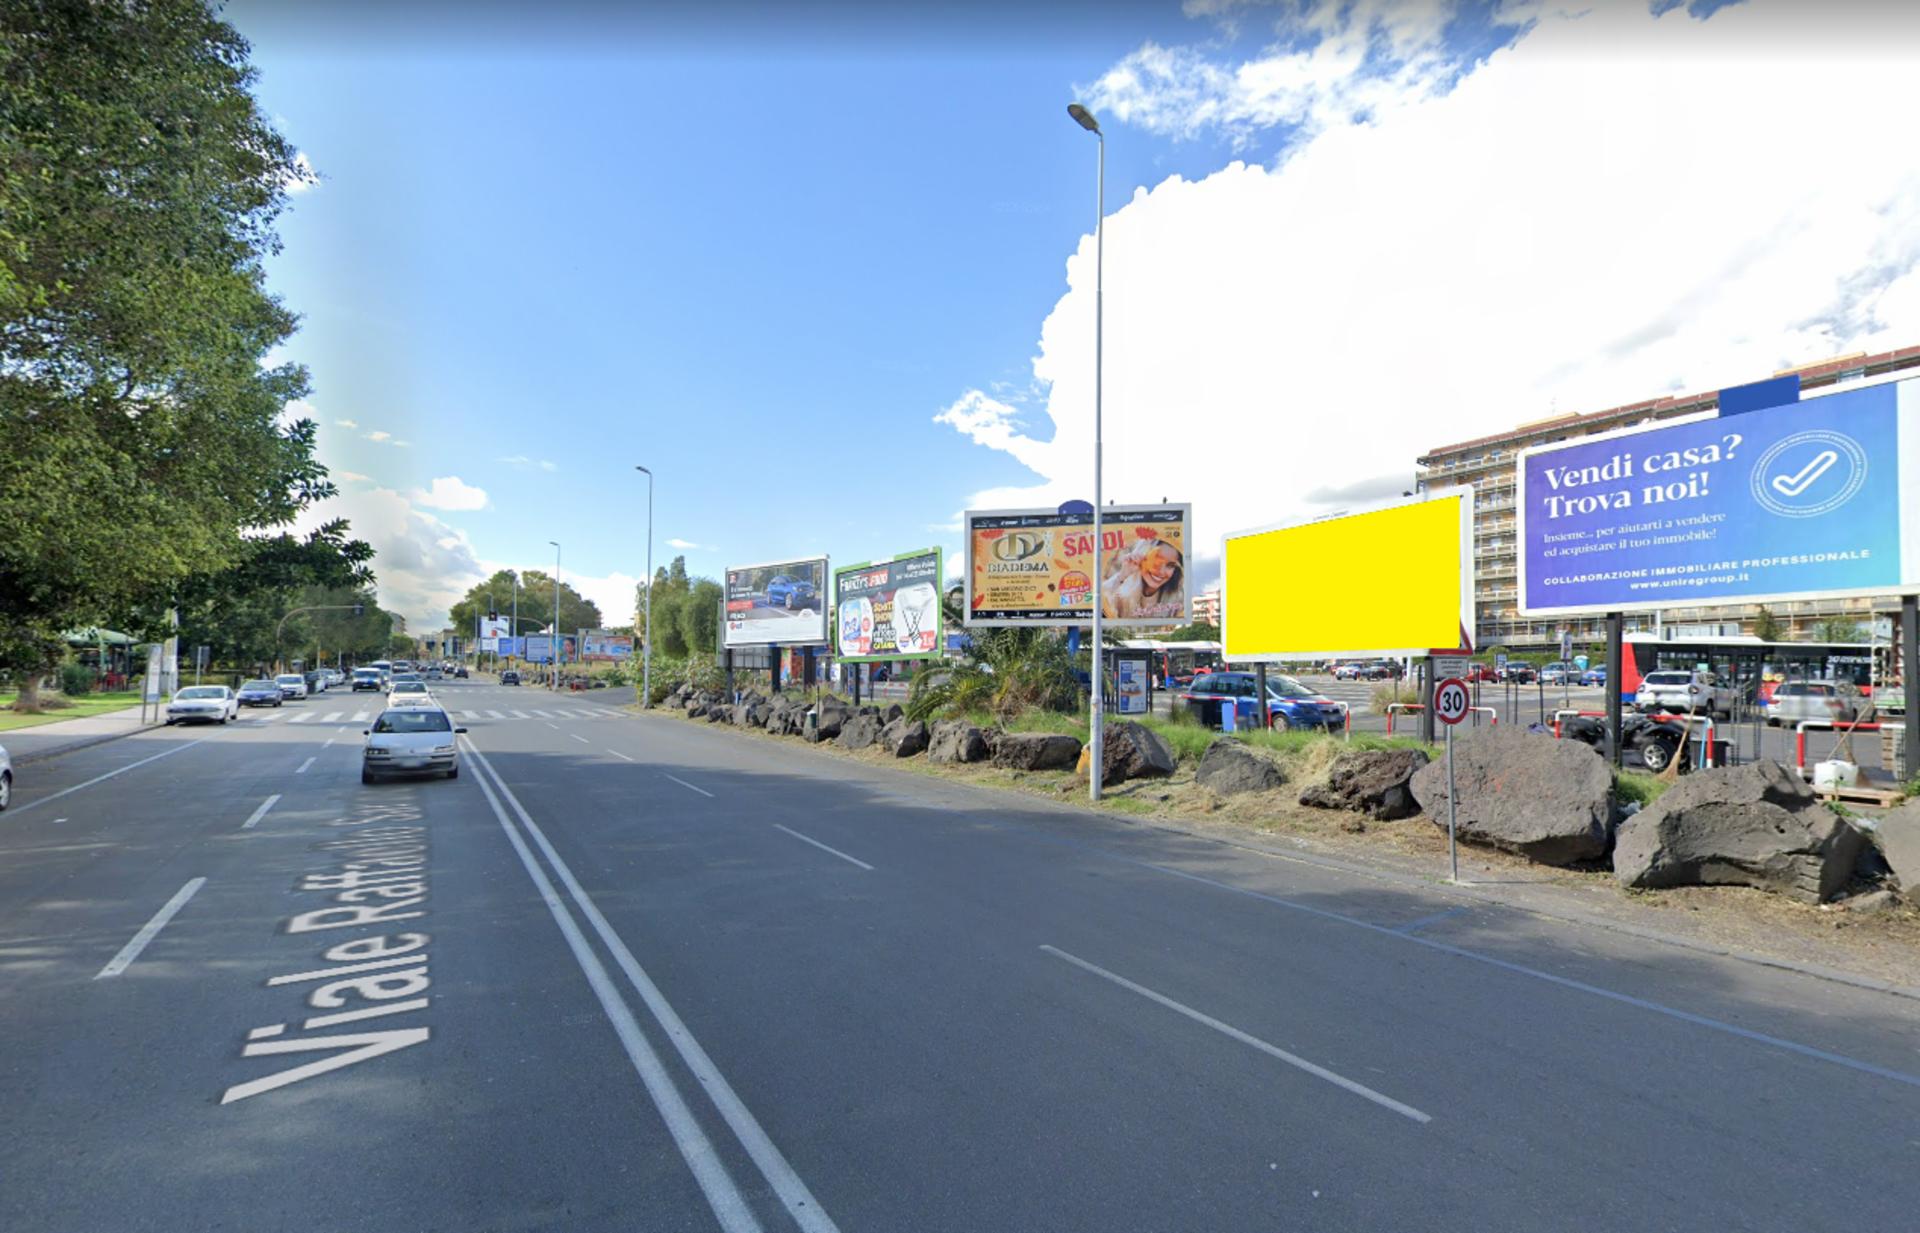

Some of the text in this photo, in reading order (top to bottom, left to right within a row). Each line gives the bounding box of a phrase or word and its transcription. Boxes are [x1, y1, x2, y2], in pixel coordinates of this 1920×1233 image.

[1544, 434, 1743, 490] Vendi casa?
[1544, 471, 1710, 519] Trova noi!
[1596, 527, 1616, 539] per
[1618, 519, 1662, 534] aiutarti
[1665, 520, 1672, 528] a
[1676, 513, 1726, 527] vendere
[1544, 528, 1717, 557] ed acquistare il tuo immobile!
[988, 562, 1049, 572] DIADEMA
[1544, 549, 1871, 586] COLLABORAZIONE IMMOBILIARE PROFESSIONALE
[1630, 572, 1749, 590] www.uniregroup.it
[1443, 691, 1462, 712] 30
